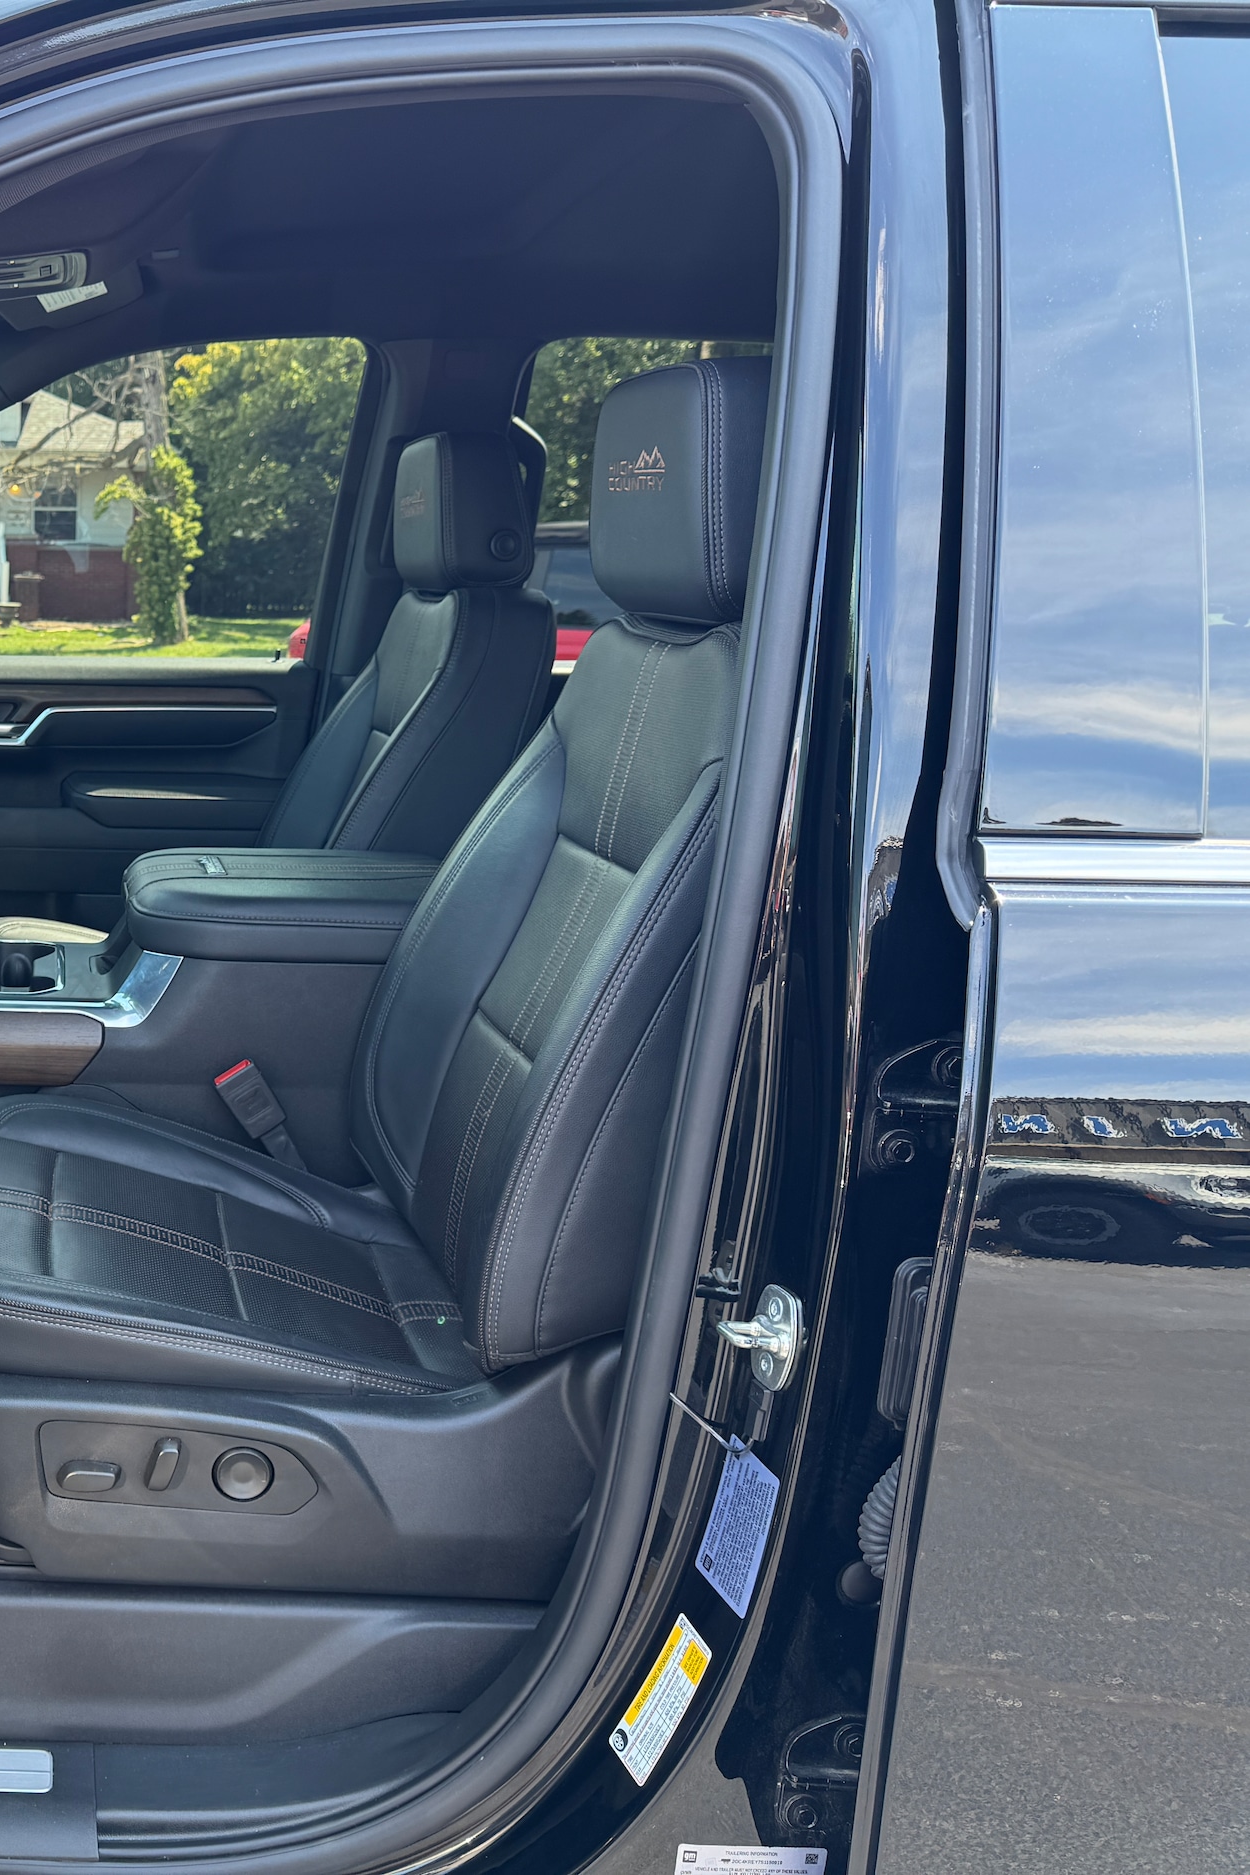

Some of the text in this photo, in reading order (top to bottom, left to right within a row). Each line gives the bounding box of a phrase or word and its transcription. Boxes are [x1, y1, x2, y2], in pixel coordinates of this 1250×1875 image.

[608, 475, 664, 492] COUNTRY
[634, 1641, 674, 1711] TIRE AND LOADING INFORMATION
[684, 1852, 696, 1860] gm
